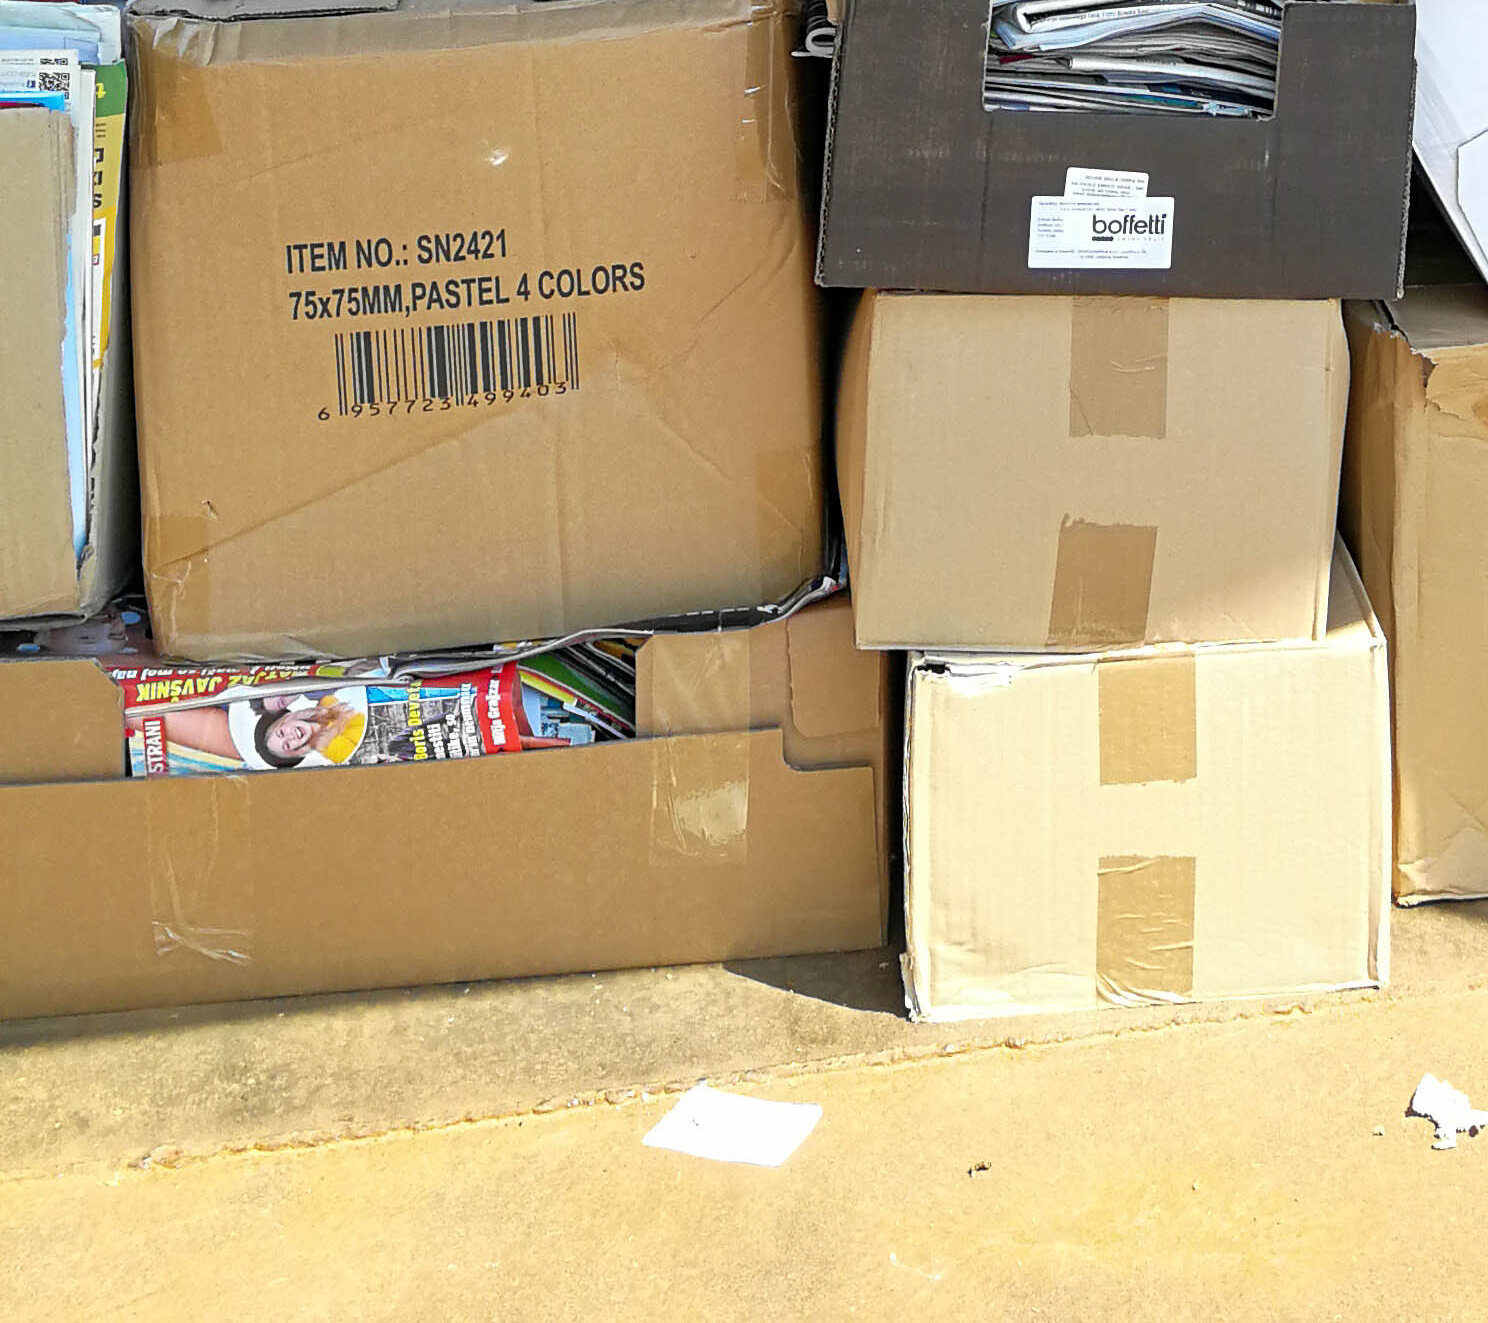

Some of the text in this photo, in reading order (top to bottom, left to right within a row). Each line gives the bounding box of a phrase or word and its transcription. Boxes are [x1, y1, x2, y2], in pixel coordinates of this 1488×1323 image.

[1092, 213, 1167, 235] boffetti
[286, 228, 508, 274] ITEM NO.: SN2421
[289, 262, 646, 321] 75x75MM,PASTEL 4 COLORS
[317, 407, 330, 421] 6
[136, 675, 223, 704] JAVŠNIK
[146, 719, 164, 775] STRANI
[410, 729, 428, 760] Boris
